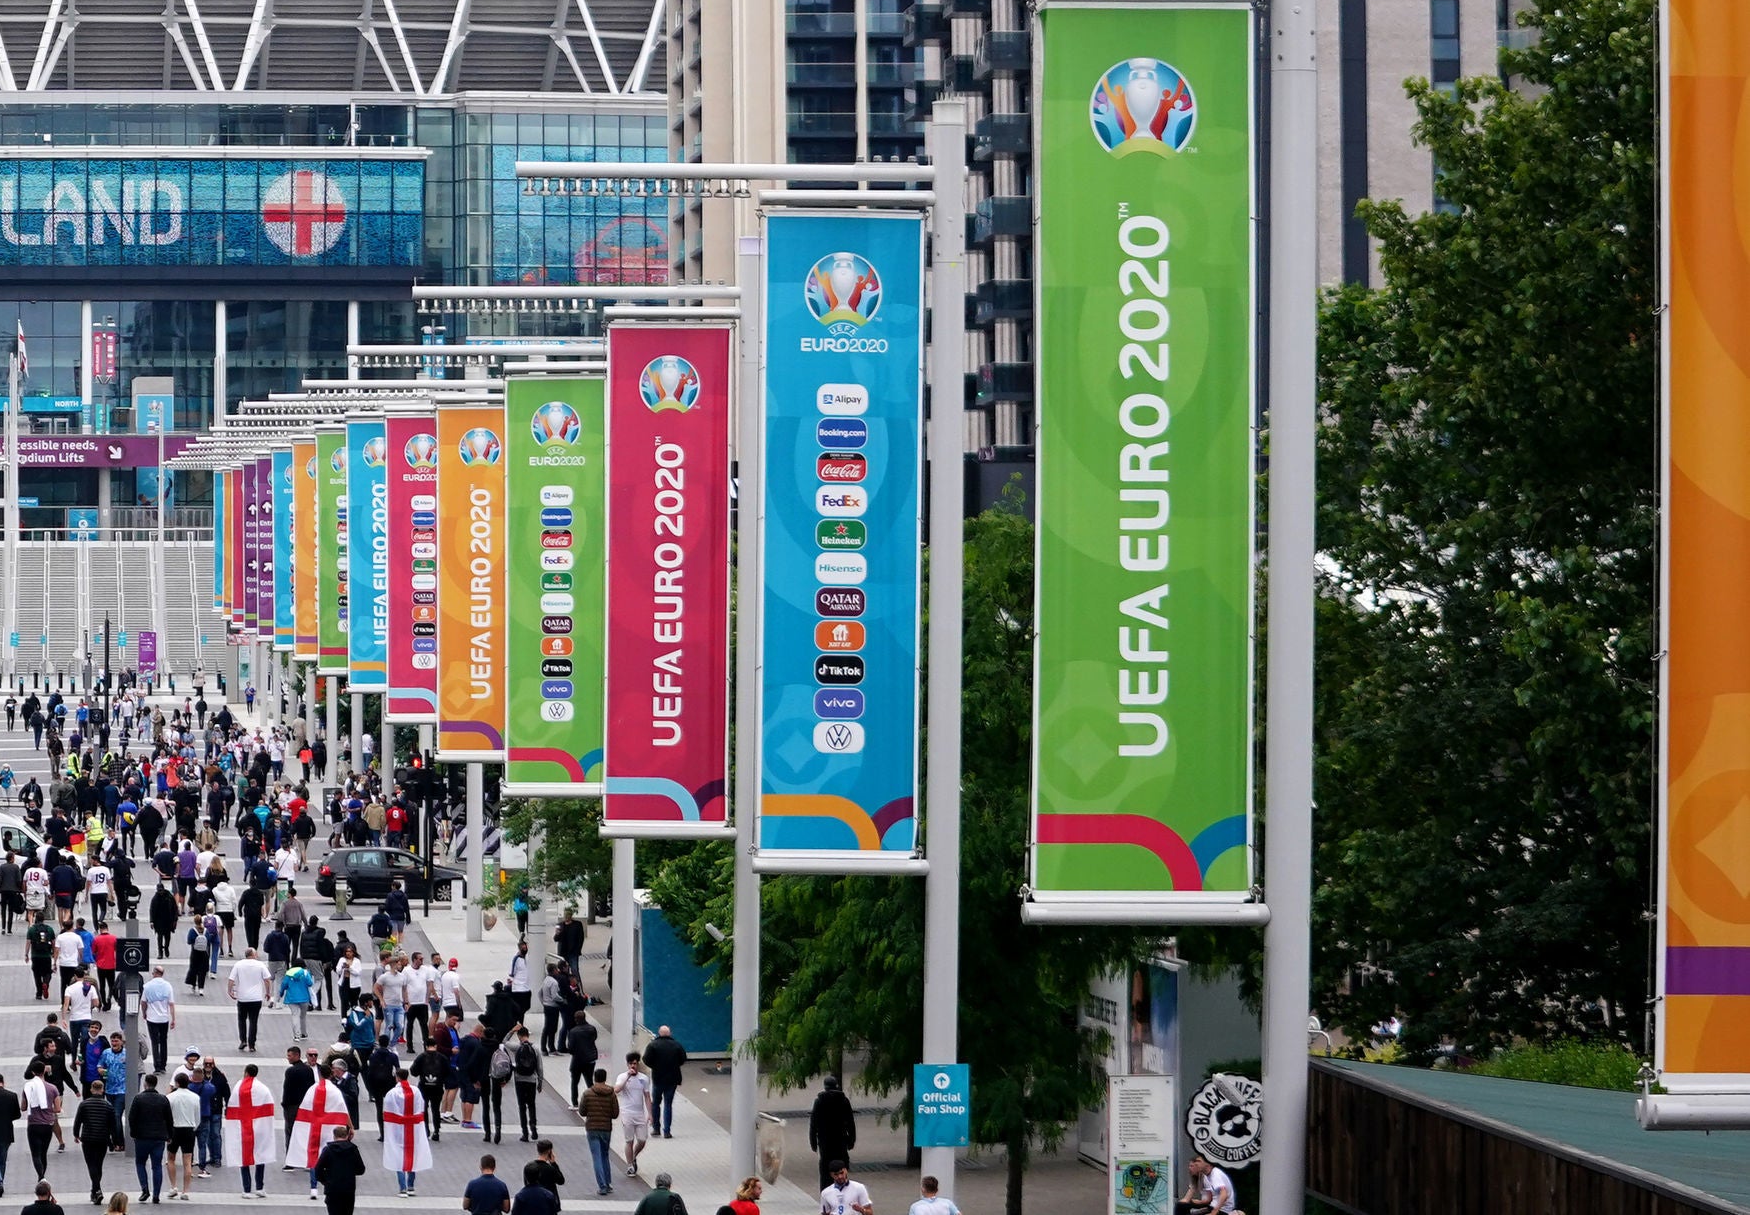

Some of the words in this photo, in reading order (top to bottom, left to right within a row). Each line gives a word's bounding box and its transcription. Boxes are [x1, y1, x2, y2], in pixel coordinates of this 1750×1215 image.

[830, 325, 856, 336] UEFA
[834, 395, 862, 405] Alipay
[819, 429, 865, 438] Booking.com
[62, 440, 98, 452] needs,
[59, 453, 85, 463] Lifts
[1118, 393, 1170, 572] EURO
[822, 494, 860, 507] FedEx
[821, 537, 861, 545] Heineken
[544, 556, 568, 565] FedEx
[819, 564, 863, 573] Hisense
[470, 557, 491, 628] EURO
[653, 543, 684, 643] EURO
[820, 593, 860, 605] QATAR
[544, 619, 570, 627] QATAR
[470, 631, 491, 700] UEFA
[828, 666, 861, 675] TikTok
[1118, 582, 1170, 757] UEFA
[652, 649, 683, 746] UEFA
[823, 699, 856, 707] vivo
[29, 872, 40, 881] 19
[95, 873, 106, 883] 19
[922, 1093, 961, 1102] Official
[918, 1105, 937, 1114] Fan
[940, 1104, 965, 1115] Shop
[1193, 1087, 1225, 1125] BLACK
